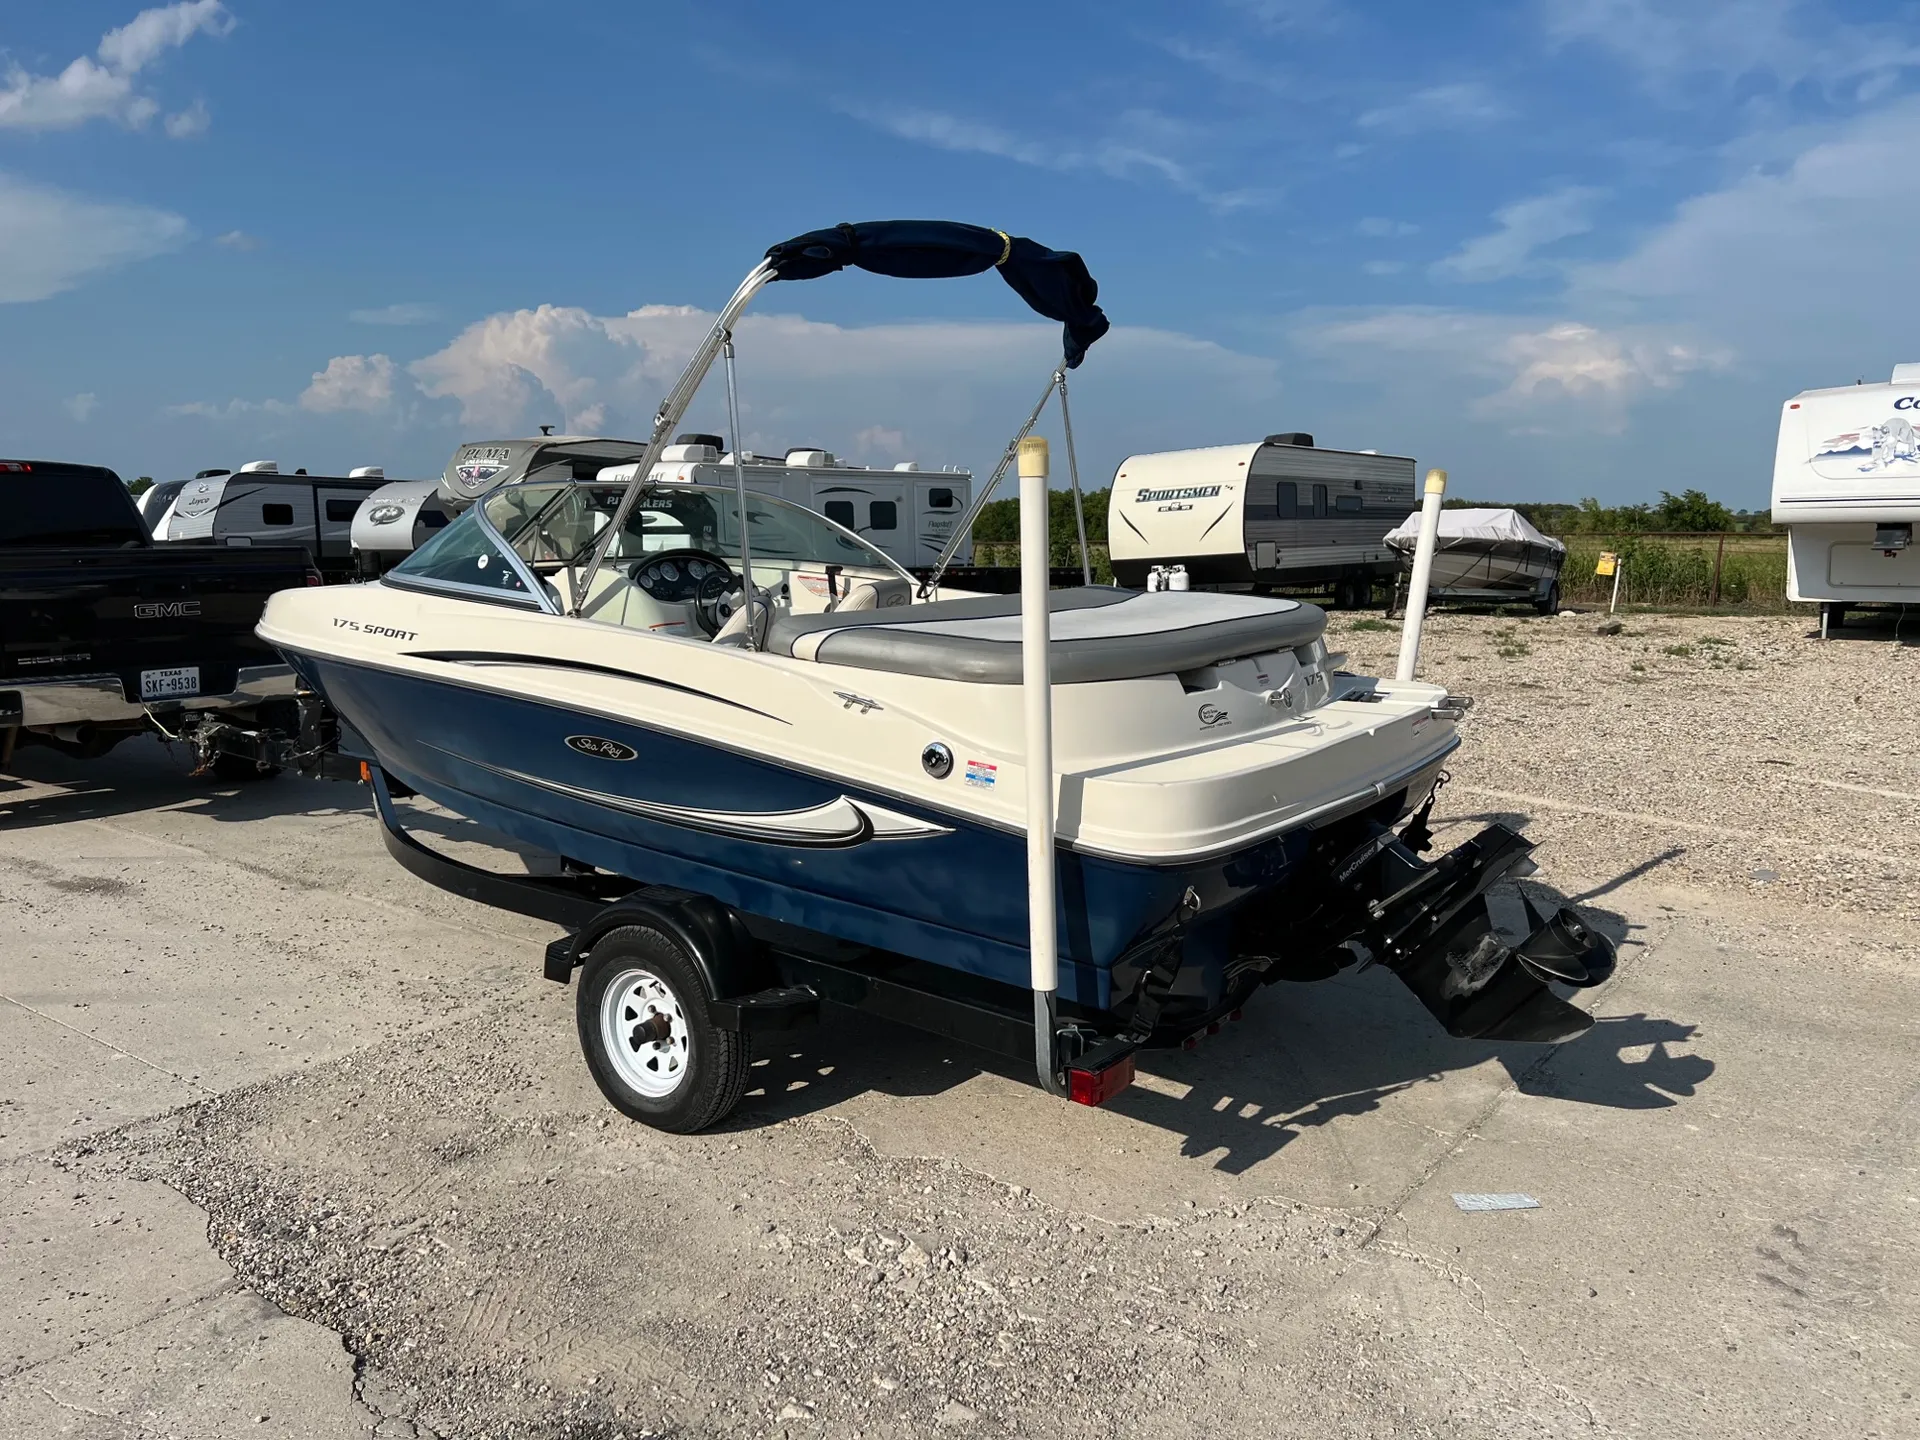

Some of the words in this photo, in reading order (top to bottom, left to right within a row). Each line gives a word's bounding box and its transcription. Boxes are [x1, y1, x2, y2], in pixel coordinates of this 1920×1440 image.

[462, 448, 511, 460] PUMA
[134, 601, 201, 618] GMC
[333, 618, 359, 631] 175
[363, 624, 418, 641] SPORT
[1304, 671, 1323, 686] 175
[577, 738, 600, 751] Sea
[600, 741, 623, 758] Ray
[1339, 846, 1375, 881] MerCruiser
